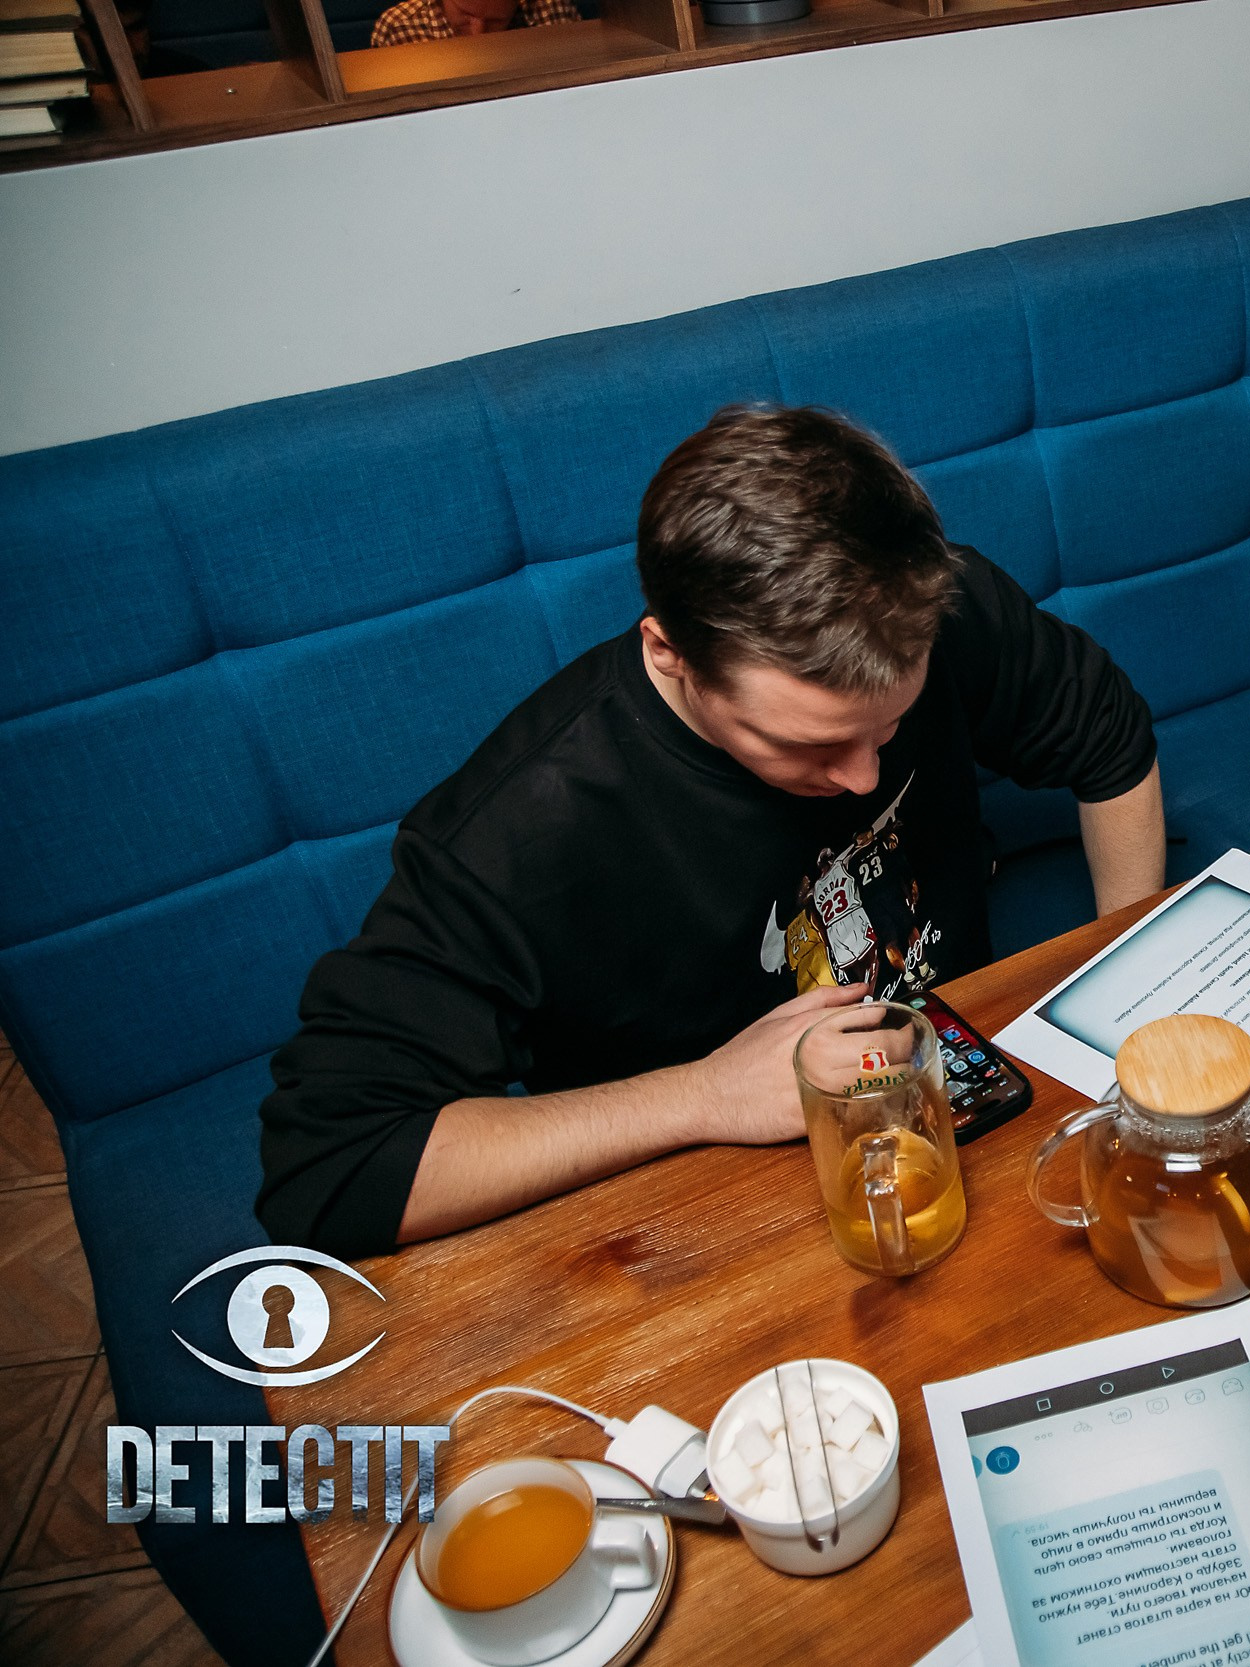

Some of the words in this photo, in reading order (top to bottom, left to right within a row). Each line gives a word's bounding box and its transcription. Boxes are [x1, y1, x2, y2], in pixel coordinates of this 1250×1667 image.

[858, 855, 884, 886] 23
[815, 877, 847, 908] JORDAN
[821, 889, 849, 923] 23
[790, 926, 808, 955] 24
[1158, 1488, 1217, 1511] вершины
[1213, 1501, 1222, 1510] и
[1130, 1504, 1211, 1533] посмотришь
[1138, 1505, 1156, 1516] ты
[1071, 1511, 1136, 1534] получишь
[1188, 1515, 1227, 1532] Когда
[1027, 1531, 1070, 1547] числа.
[1086, 1528, 1128, 1546] прямо
[1165, 1528, 1232, 1553] головами.
[1169, 1527, 1187, 1538] ты
[1040, 1543, 1072, 1559] лицо
[1075, 1540, 1084, 1549] в
[1104, 1532, 1167, 1555] отыщешь
[1200, 1542, 1237, 1558] стать
[1033, 1560, 1065, 1575] цель
[1067, 1551, 1102, 1566] свою
[1124, 1553, 1199, 1582] настоящим
[1195, 1557, 1242, 1575] Забудь
[1184, 1571, 1193, 1580] о
[1189, 1570, 1247, 1594] началом
[1049, 1576, 1122, 1603] охотником
[1143, 1589, 1186, 1608] твоего
[1213, 1591, 1231, 1603] на
[1031, 1597, 1046, 1608] за
[1109, 1602, 1140, 1618] пути.
[1175, 1597, 1211, 1615] карте
[1037, 1603, 1081, 1623] нужно
[1123, 1608, 1172, 1629] штатов
[1077, 1624, 1121, 1645] станет
[1221, 1632, 1243, 1649] get
[1198, 1641, 1220, 1655] the
